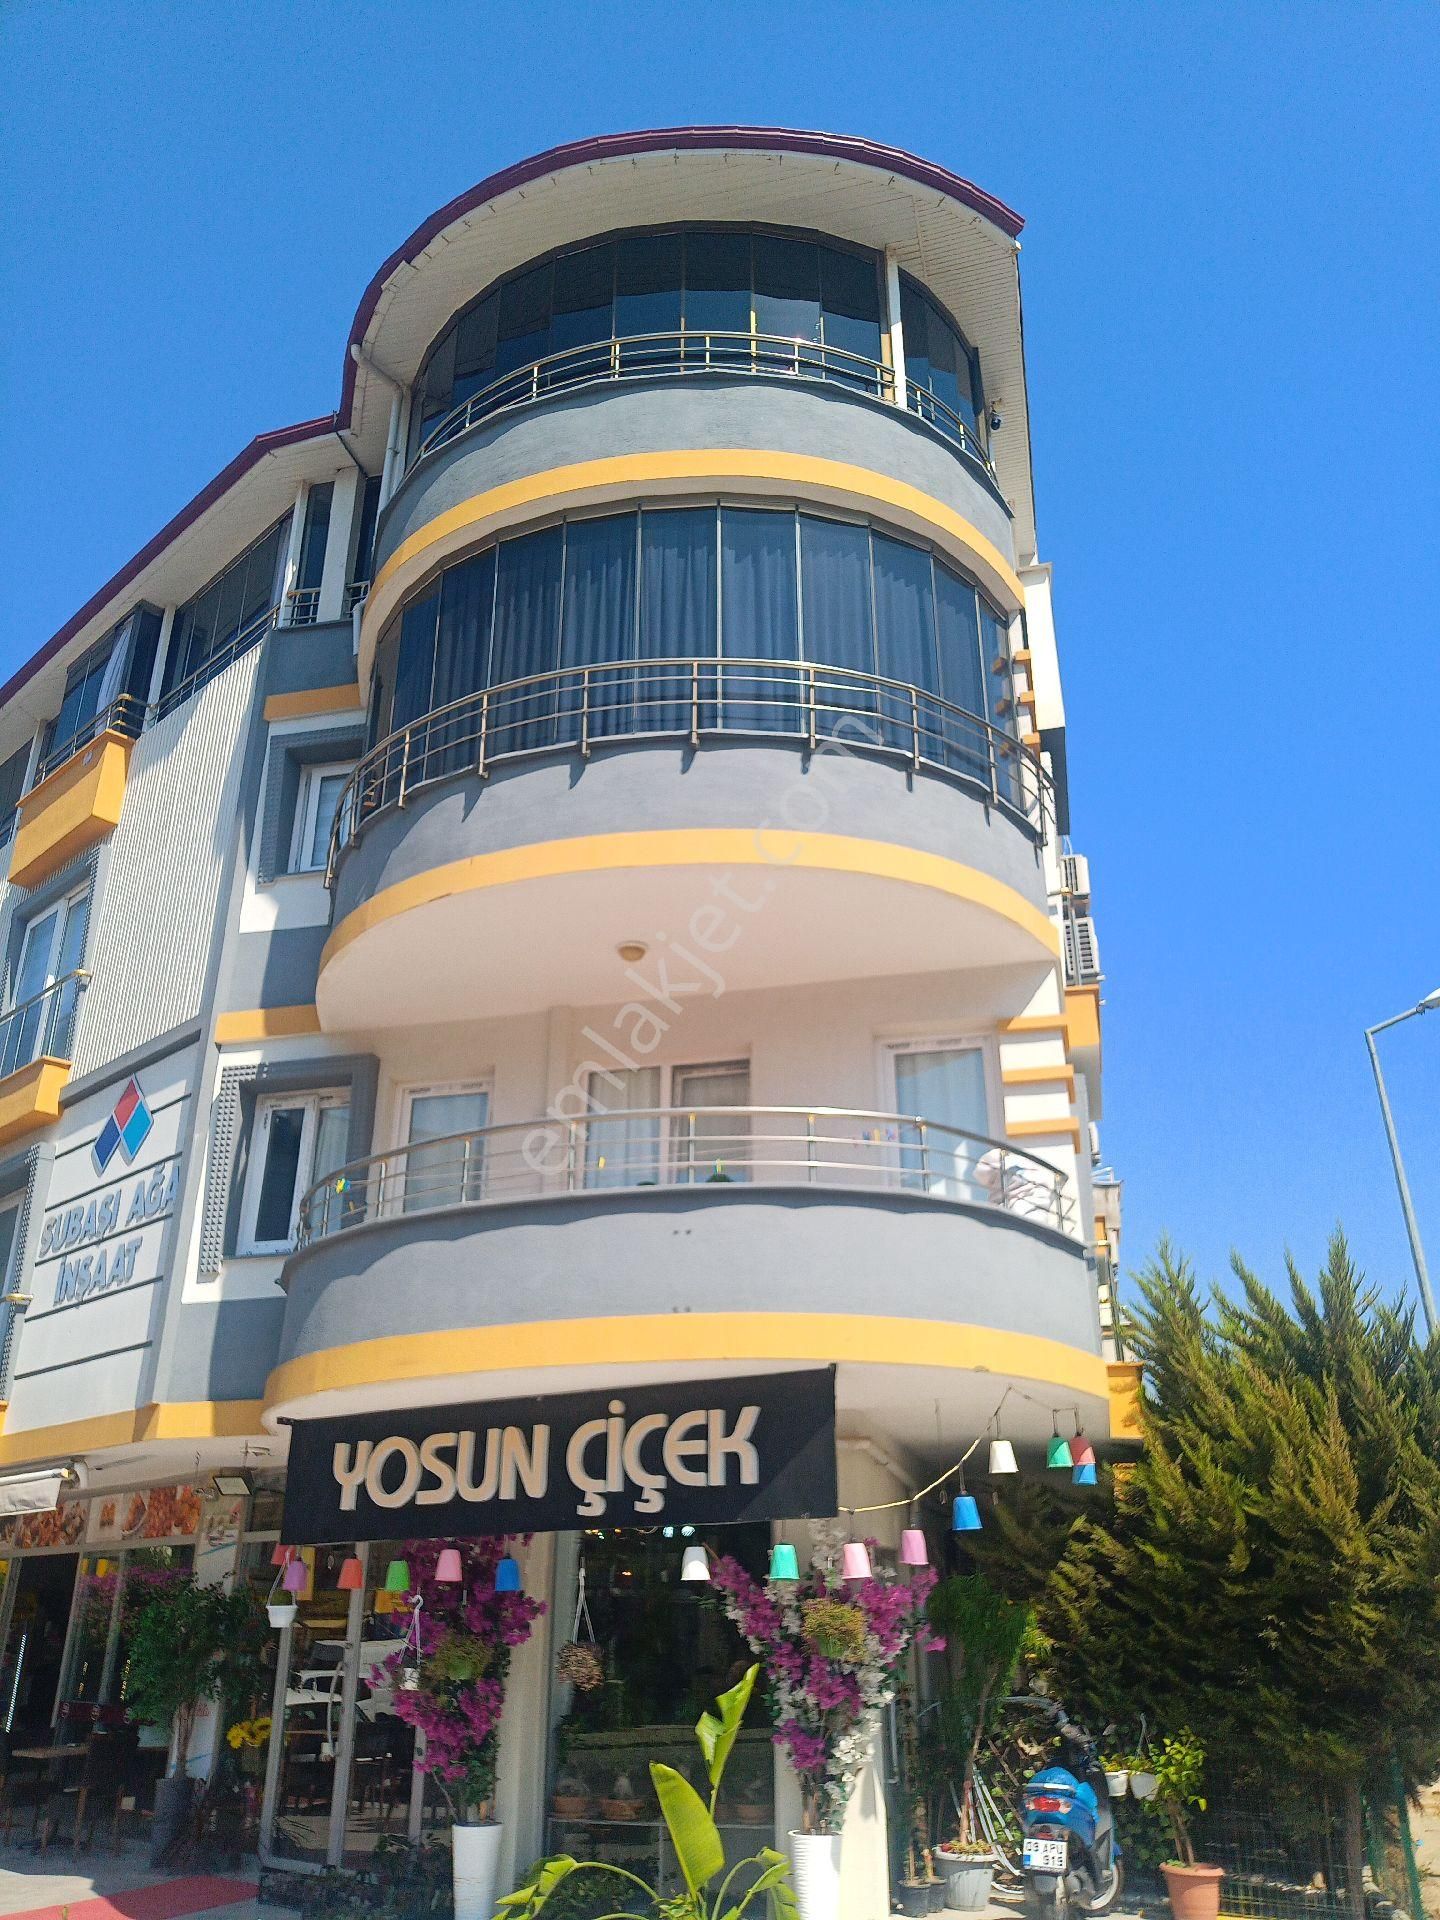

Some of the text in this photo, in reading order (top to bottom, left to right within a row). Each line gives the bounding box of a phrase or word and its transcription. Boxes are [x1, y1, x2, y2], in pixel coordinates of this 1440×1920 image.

[126, 1162, 180, 1227] AĞA
[332, 1399, 761, 1517] YOSUN ÇİÇEK
